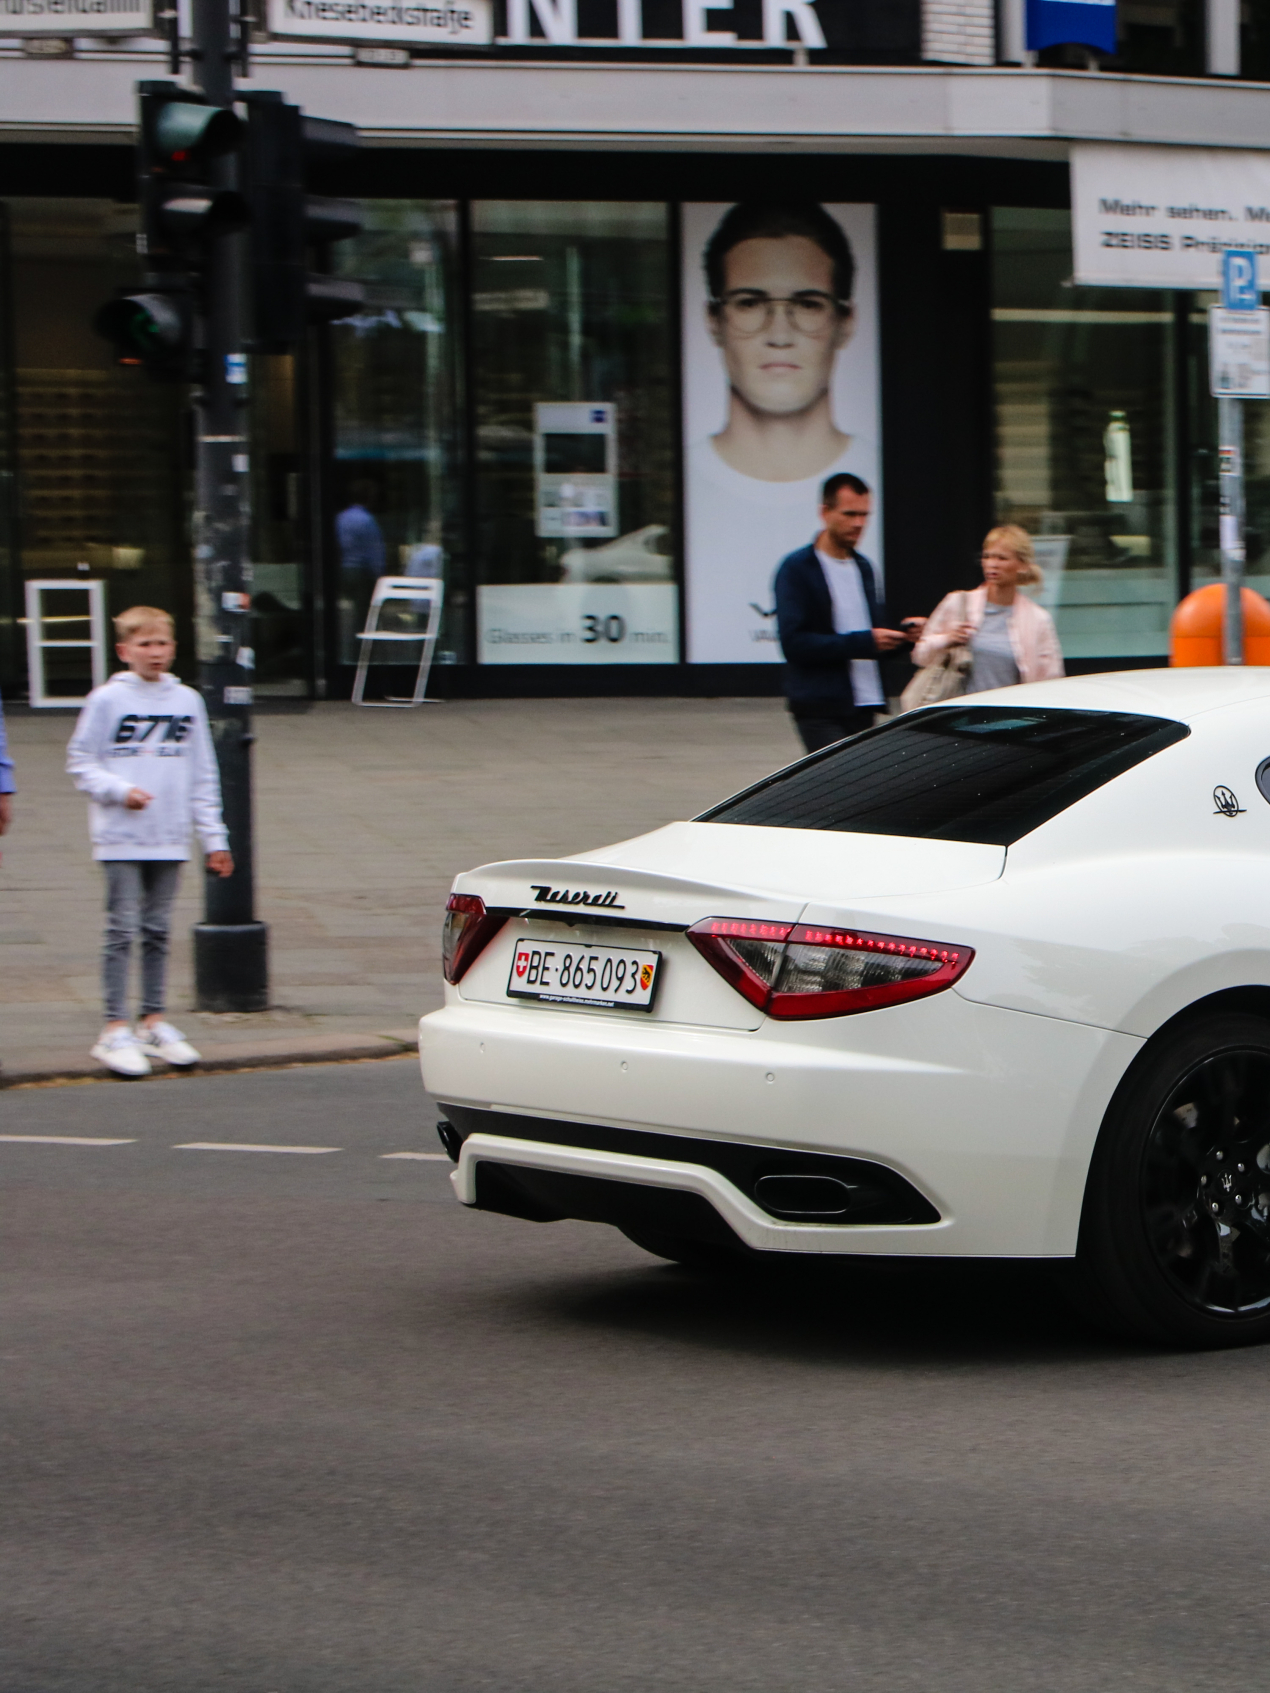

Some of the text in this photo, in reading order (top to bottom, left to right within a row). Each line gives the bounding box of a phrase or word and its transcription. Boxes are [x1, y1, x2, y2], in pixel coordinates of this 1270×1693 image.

[1099, 198, 1158, 217] Mehr
[1166, 203, 1238, 222] sehen.
[1101, 231, 1171, 251] ZEISS
[580, 614, 627, 644] 30
[531, 885, 626, 909] Maserati
